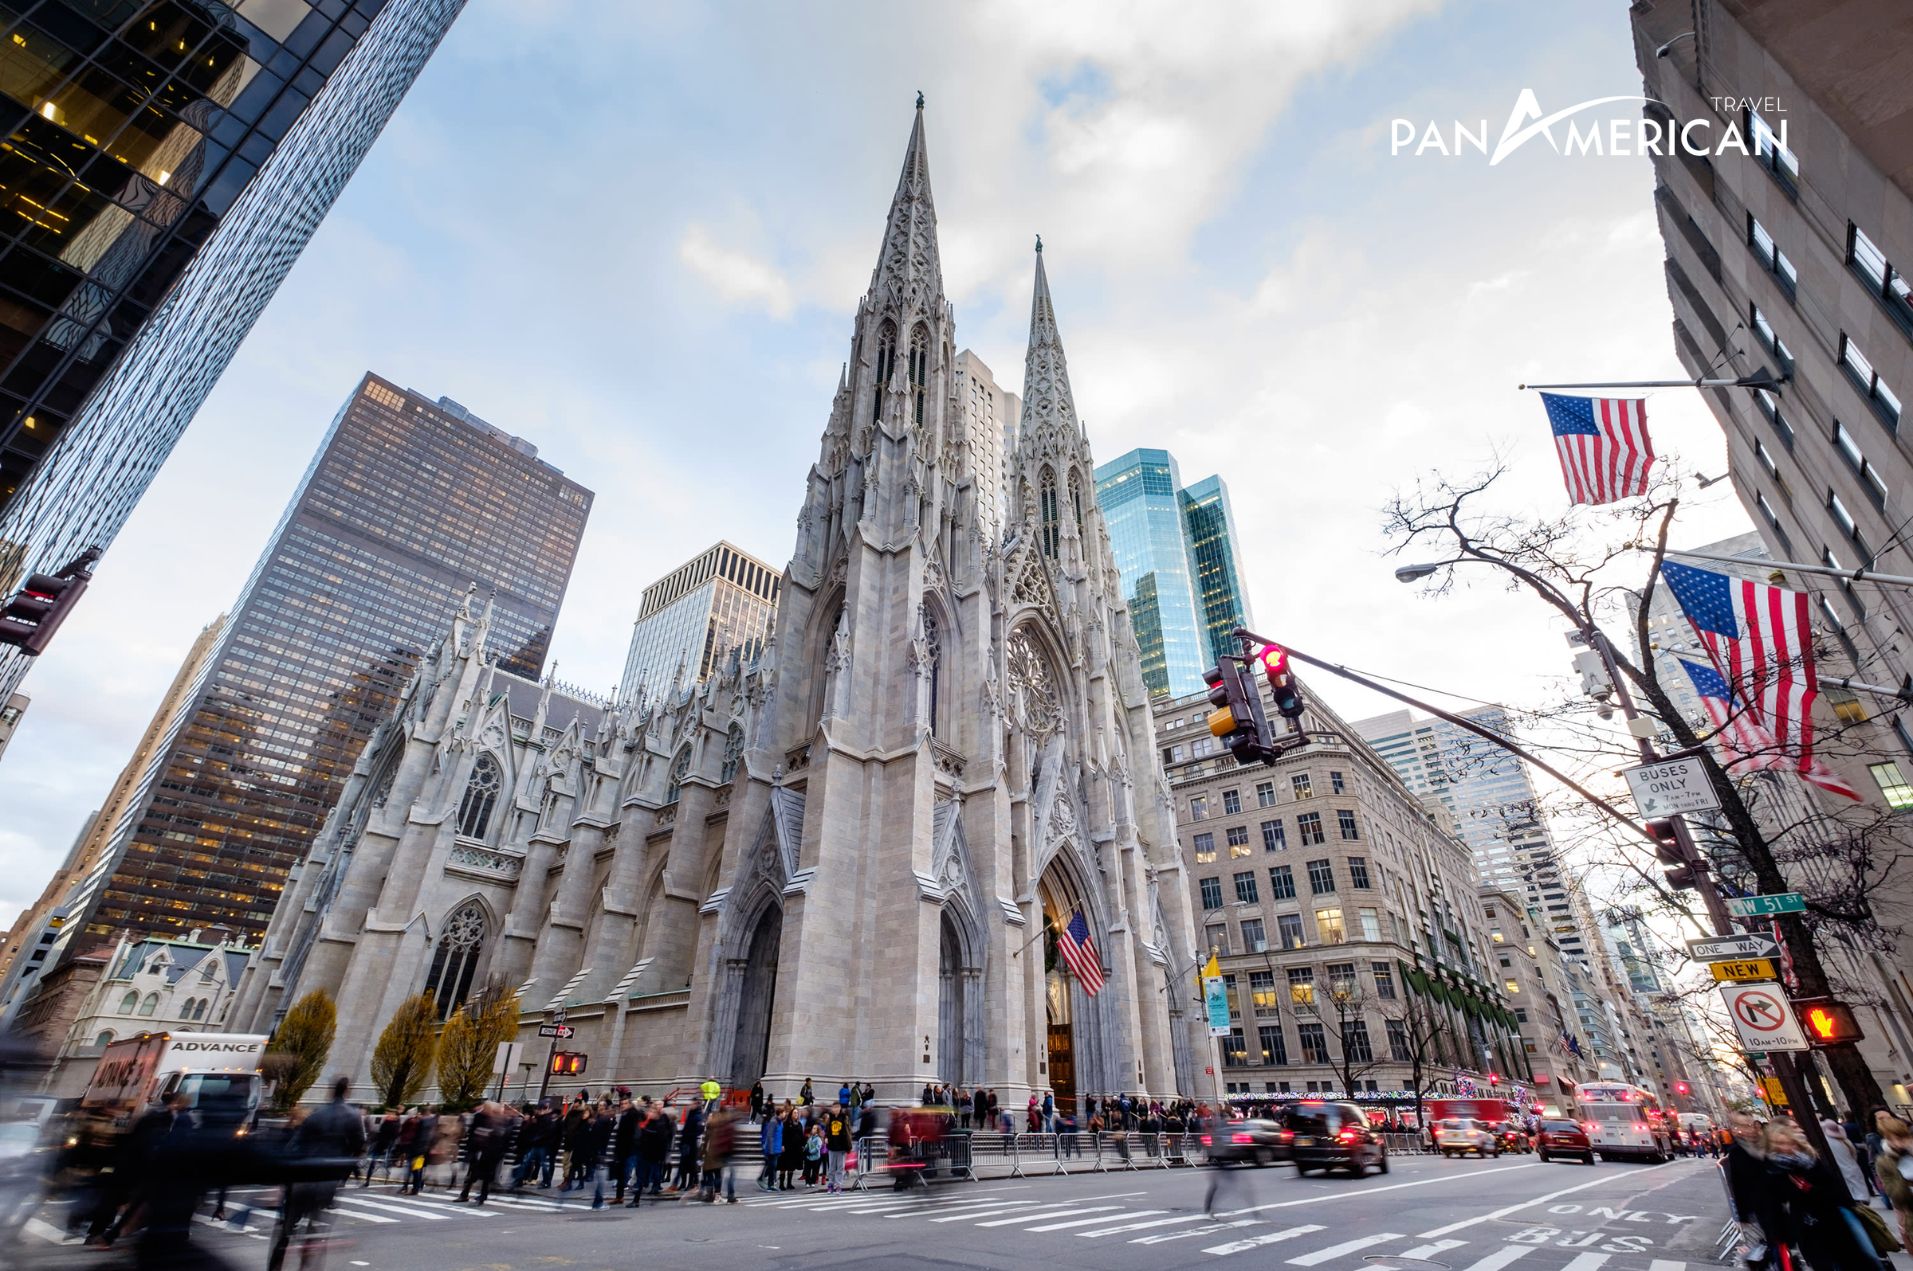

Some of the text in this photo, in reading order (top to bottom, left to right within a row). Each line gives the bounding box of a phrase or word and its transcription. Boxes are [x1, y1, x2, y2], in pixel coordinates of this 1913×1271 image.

[1639, 764, 1688, 782] BUSES
[1649, 778, 1686, 793] ONLY
[1695, 798, 1709, 806] FRI
[1742, 895, 1798, 914] W 51 ST
[1696, 940, 1764, 955] ONE WAY
[1723, 963, 1760, 977] NEW
[171, 1042, 259, 1053] ADVANCE
[1547, 1204, 1698, 1225] ONLY
[1502, 1226, 1655, 1253] BUS
